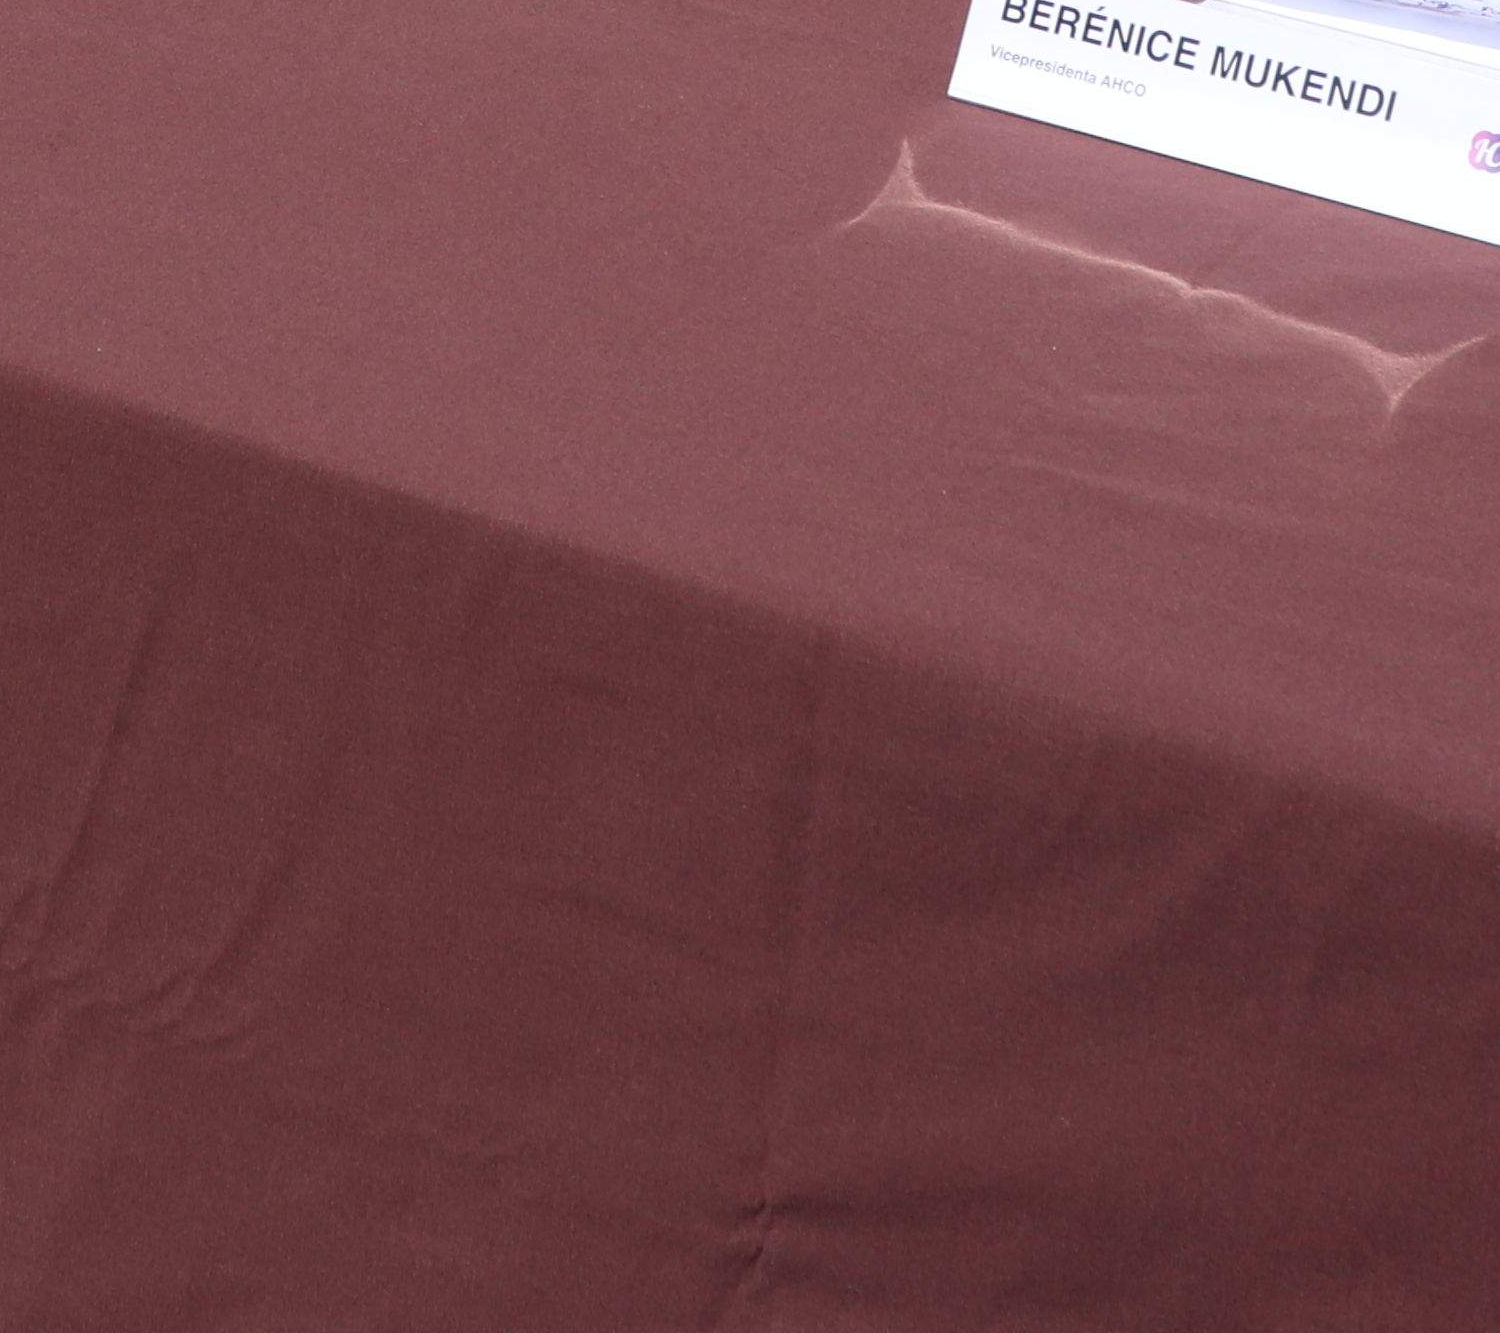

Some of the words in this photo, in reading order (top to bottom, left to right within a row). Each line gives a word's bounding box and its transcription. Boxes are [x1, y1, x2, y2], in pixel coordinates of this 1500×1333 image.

[990, 44, 1096, 84] Vicepresidenta
[1101, 75, 1146, 97] AHCO
[1209, 43, 1397, 124] MUKENDI
